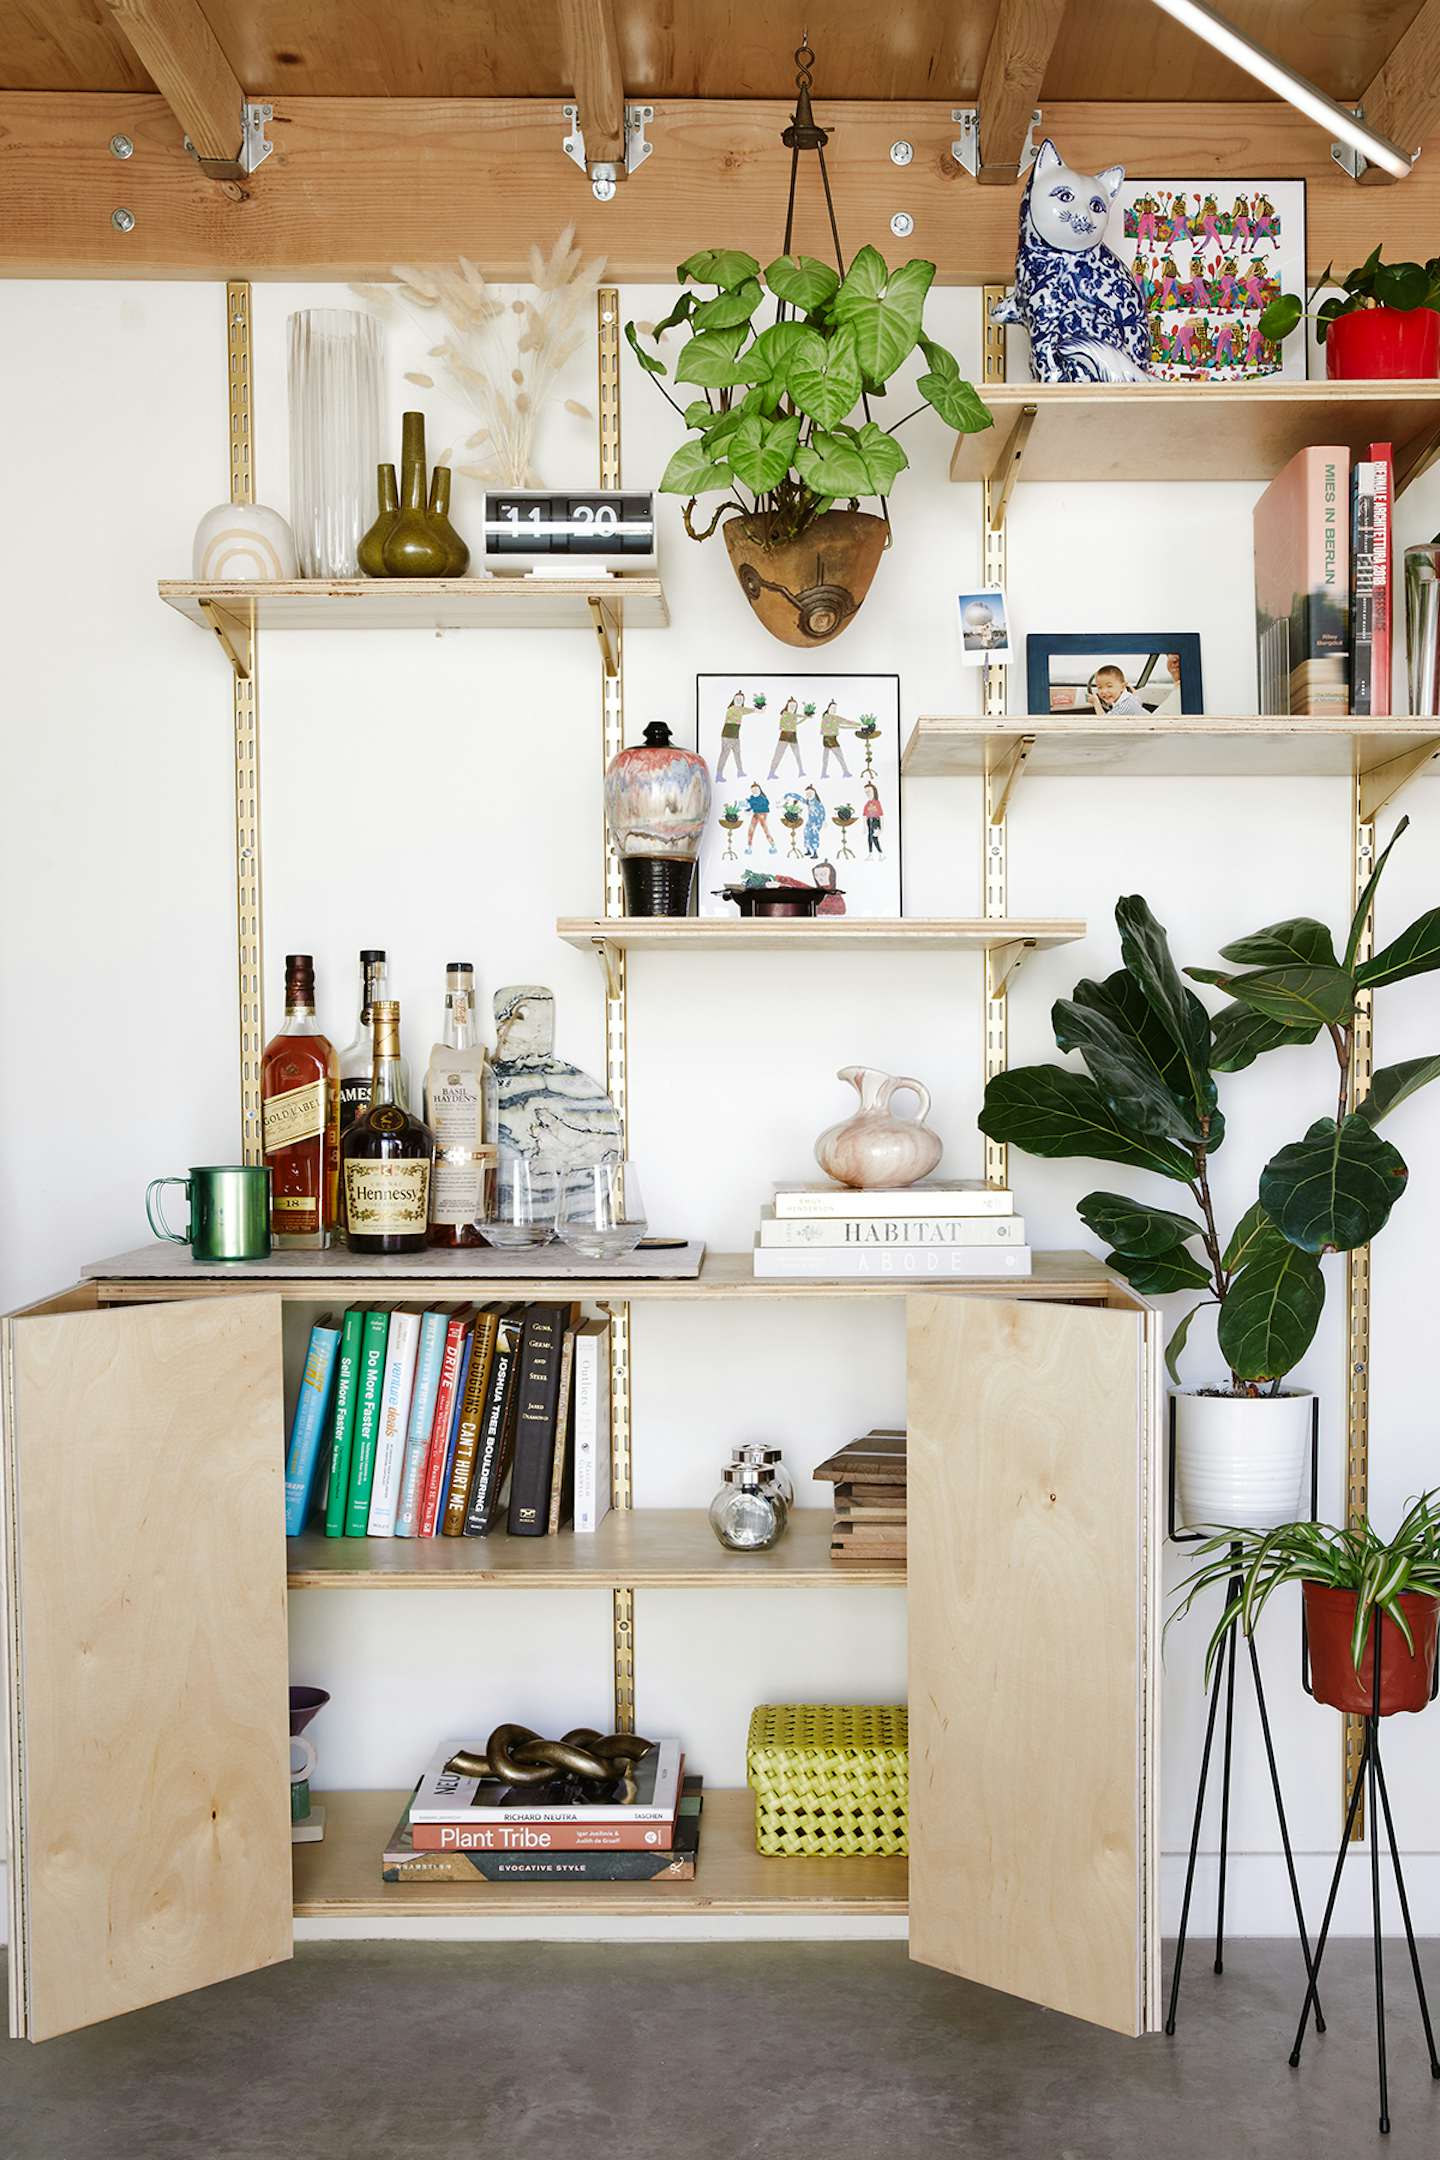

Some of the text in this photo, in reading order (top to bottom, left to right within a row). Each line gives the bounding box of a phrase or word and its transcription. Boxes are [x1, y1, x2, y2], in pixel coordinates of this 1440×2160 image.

[1374, 460, 1387, 500] BIENNALE
[506, 505, 617, 538] 11 20
[1325, 464, 1334, 583] MIES IN BERLIN
[1372, 502, 1386, 563] ARCHITETTURA
[1372, 564, 1385, 585] 2018
[340, 1087, 371, 1103] AMES
[263, 1109, 289, 1126] GOLD
[357, 1186, 416, 1202] Hennessy
[845, 1223, 962, 1242] HABITAT
[858, 1252, 961, 1271] ABODE
[340, 1357, 352, 1377] Sell
[387, 1361, 404, 1405] venture
[441, 1345, 458, 1389] DRIVE
[464, 1323, 491, 1414] DAVID GOGGINS
[492, 1356, 508, 1403] JOSHUA
[580, 1360, 591, 1406] Outliers
[337, 1379, 349, 1406] More
[360, 1349, 379, 1438] Do More Faster
[334, 1407, 347, 1440] Faster
[384, 1405, 400, 1437] deals
[487, 1403, 500, 1435] TREE
[429, 1464, 441, 1489] Daniel
[448, 1421, 476, 1511] CAN'T HURT ME
[473, 1436, 495, 1512] BOULDERING
[441, 1828, 551, 1847] Plant Tribe
[556, 1864, 586, 1872] STYLE
